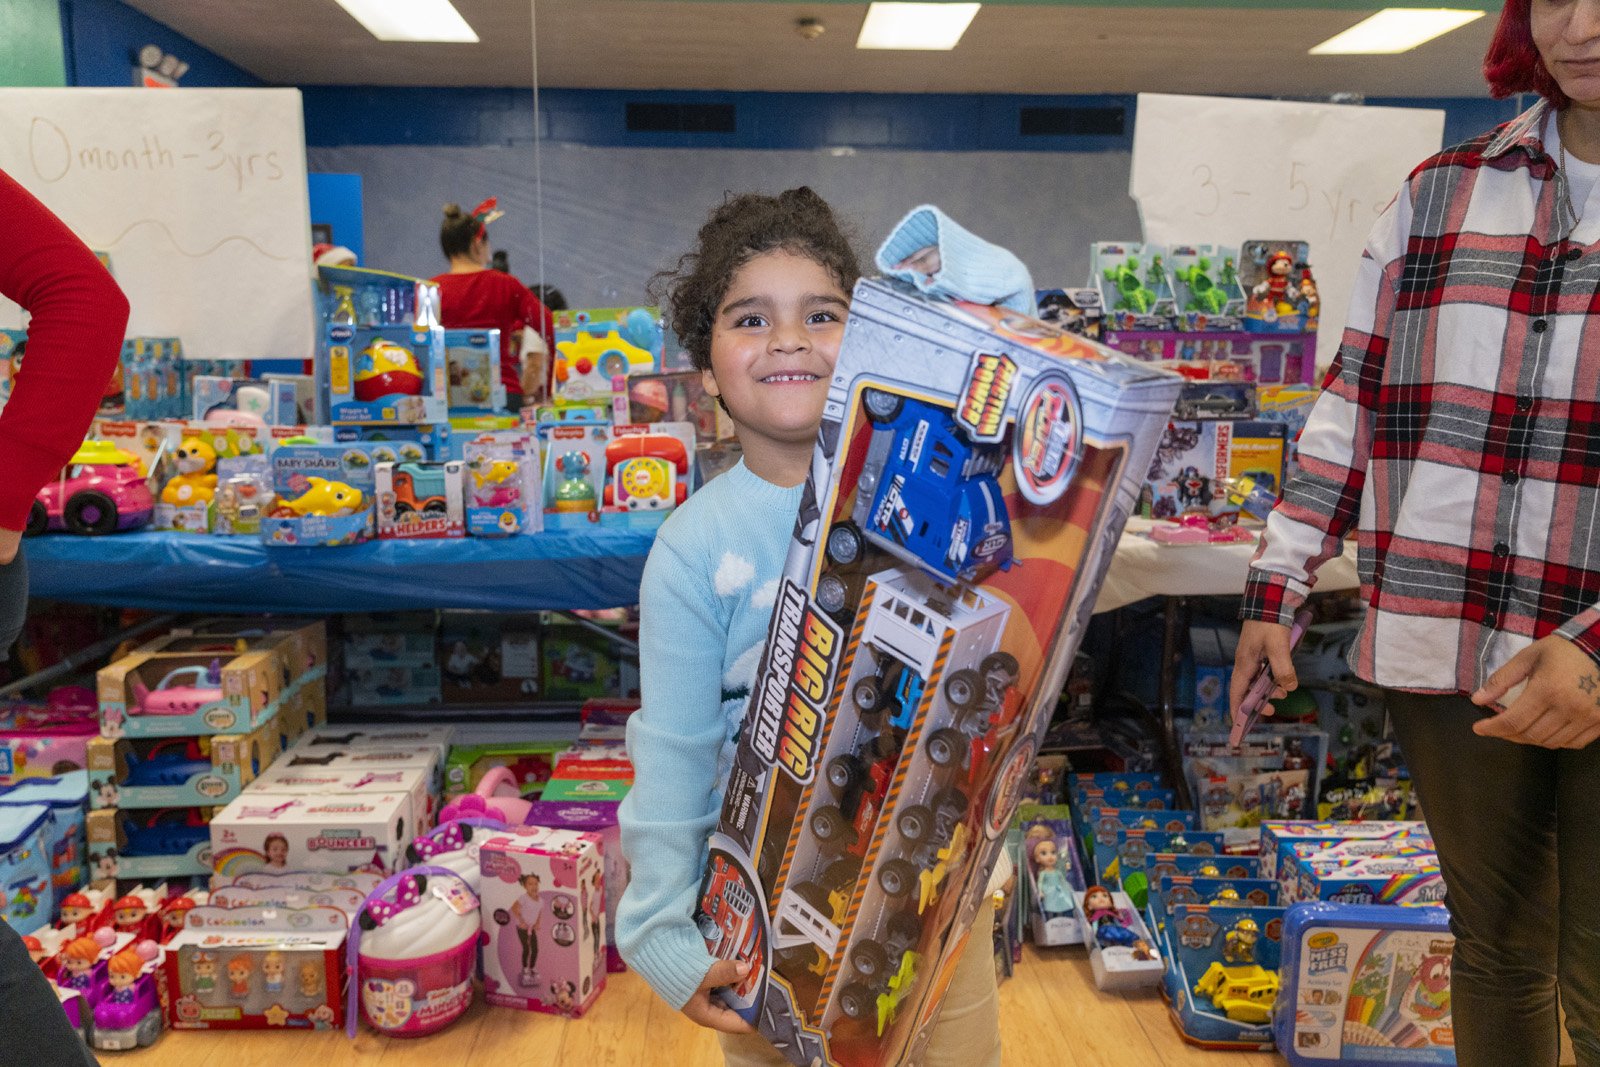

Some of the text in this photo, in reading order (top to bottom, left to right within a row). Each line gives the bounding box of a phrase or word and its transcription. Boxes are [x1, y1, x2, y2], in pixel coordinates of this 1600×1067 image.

[960, 353, 999, 427] POWER
[977, 353, 1019, 438] FRICTION
[304, 456, 339, 469] SHARK
[755, 583, 808, 761] TRANSPORTER
[779, 611, 835, 778] BIG RIG
[735, 794, 753, 831] WARNING:
[1311, 947, 1346, 960] MESS
[1311, 958, 1346, 972] FREE
